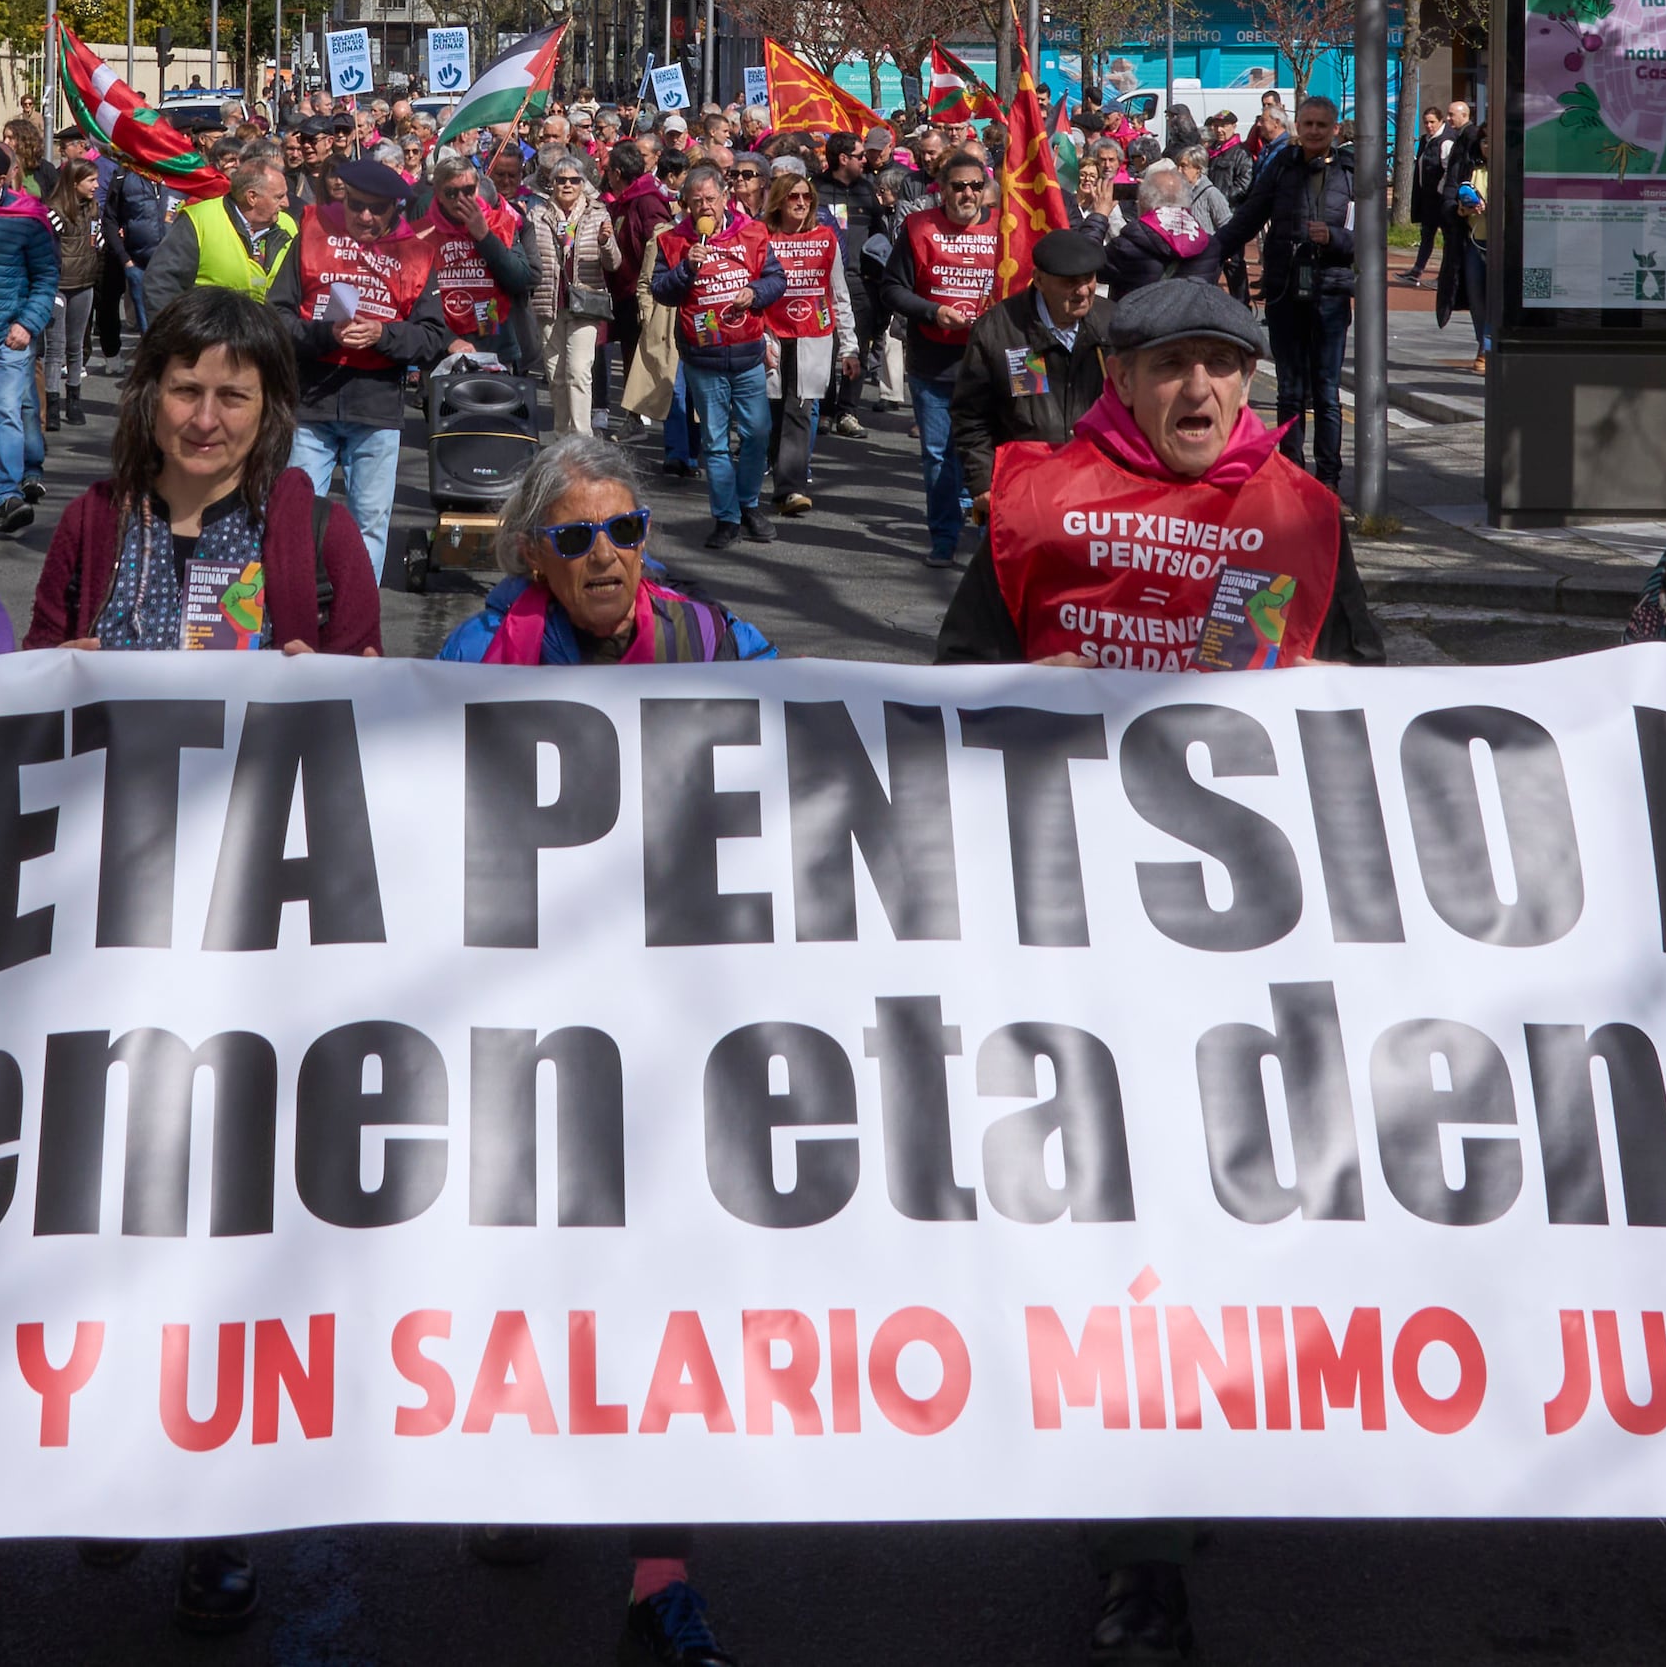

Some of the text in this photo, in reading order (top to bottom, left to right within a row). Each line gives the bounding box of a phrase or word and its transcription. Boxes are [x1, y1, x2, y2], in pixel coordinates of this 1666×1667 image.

[331, 33, 362, 42] SOLDATA
[332, 39, 364, 48] PENTSIO
[332, 44, 364, 54] DUINAK
[432, 43, 465, 51] DUINAK
[774, 249, 823, 258] PENTSIOA
[940, 243, 994, 255] PENTSIOA
[941, 276, 985, 288] SOLDAT
[1063, 511, 1264, 552] GUTXIENEKO
[1089, 541, 1228, 581] PENTSIOA
[190, 571, 230, 585] DUINAK
[1221, 574, 1259, 591] DUINAK
[189, 584, 213, 594] orain,
[1218, 585, 1241, 596] orain,
[188, 592, 217, 604] hemen
[1215, 593, 1244, 606] hemen
[187, 603, 202, 612] eta
[1213, 602, 1227, 611] eta
[187, 612, 223, 622] DENONTZAT
[1211, 610, 1246, 624] DENONTZAT
[1080, 640, 1199, 672] SOLDAT
[465, 698, 1583, 953] PENTSIO
[702, 995, 1136, 1230] eta
[16, 1322, 105, 1449] Y
[160, 1311, 336, 1454] UN
[391, 1306, 972, 1438] SALARIO
[1025, 1263, 1488, 1436] MÍNIMO
